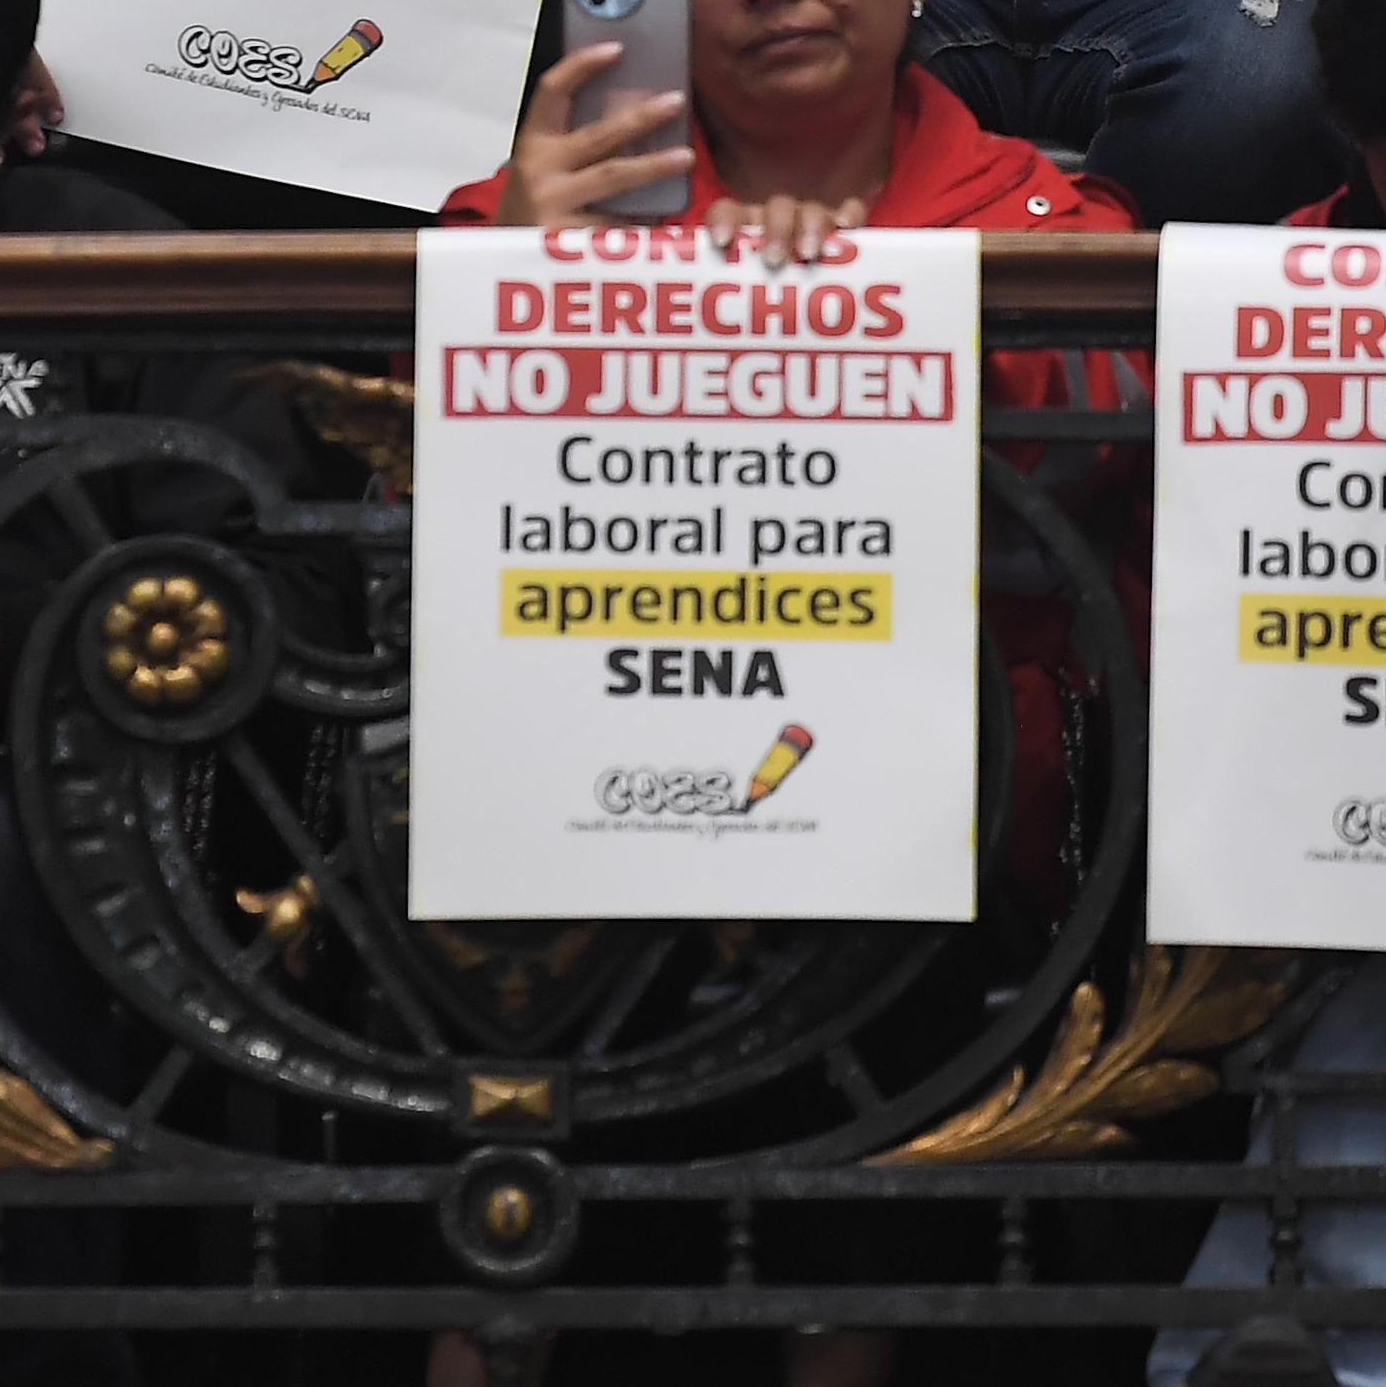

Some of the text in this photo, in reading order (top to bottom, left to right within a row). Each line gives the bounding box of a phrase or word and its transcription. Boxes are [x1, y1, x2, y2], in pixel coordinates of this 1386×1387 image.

[177, 25, 303, 88] COES
[544, 227, 697, 263] CON
[498, 281, 905, 339] DERECHOS
[453, 350, 944, 417] NO JUEGUEN
[1193, 376, 1307, 438] NO
[561, 437, 836, 485] Contrato
[504, 506, 890, 565] laboral para
[519, 578, 874, 633] aprendices
[608, 649, 784, 697] SENA
